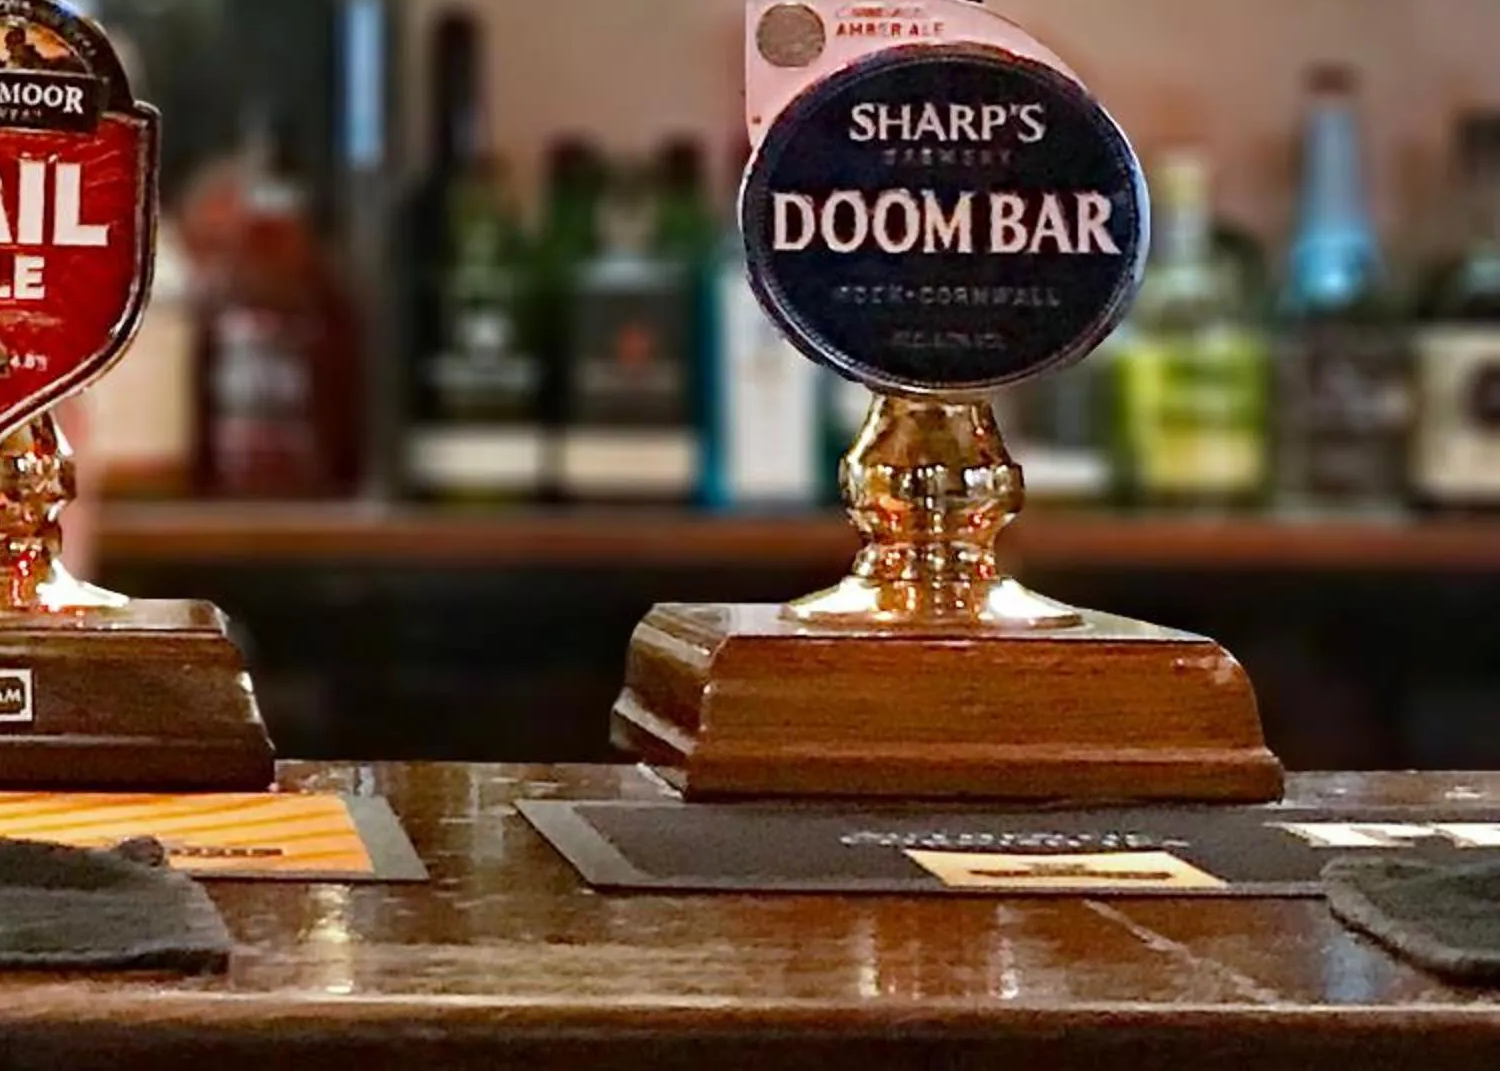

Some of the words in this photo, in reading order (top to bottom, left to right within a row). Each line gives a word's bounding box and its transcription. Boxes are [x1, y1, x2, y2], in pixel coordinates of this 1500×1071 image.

[849, 101, 1047, 143] SHARP'S
[773, 189, 976, 255] DOOM
[990, 189, 1122, 255] BAR
